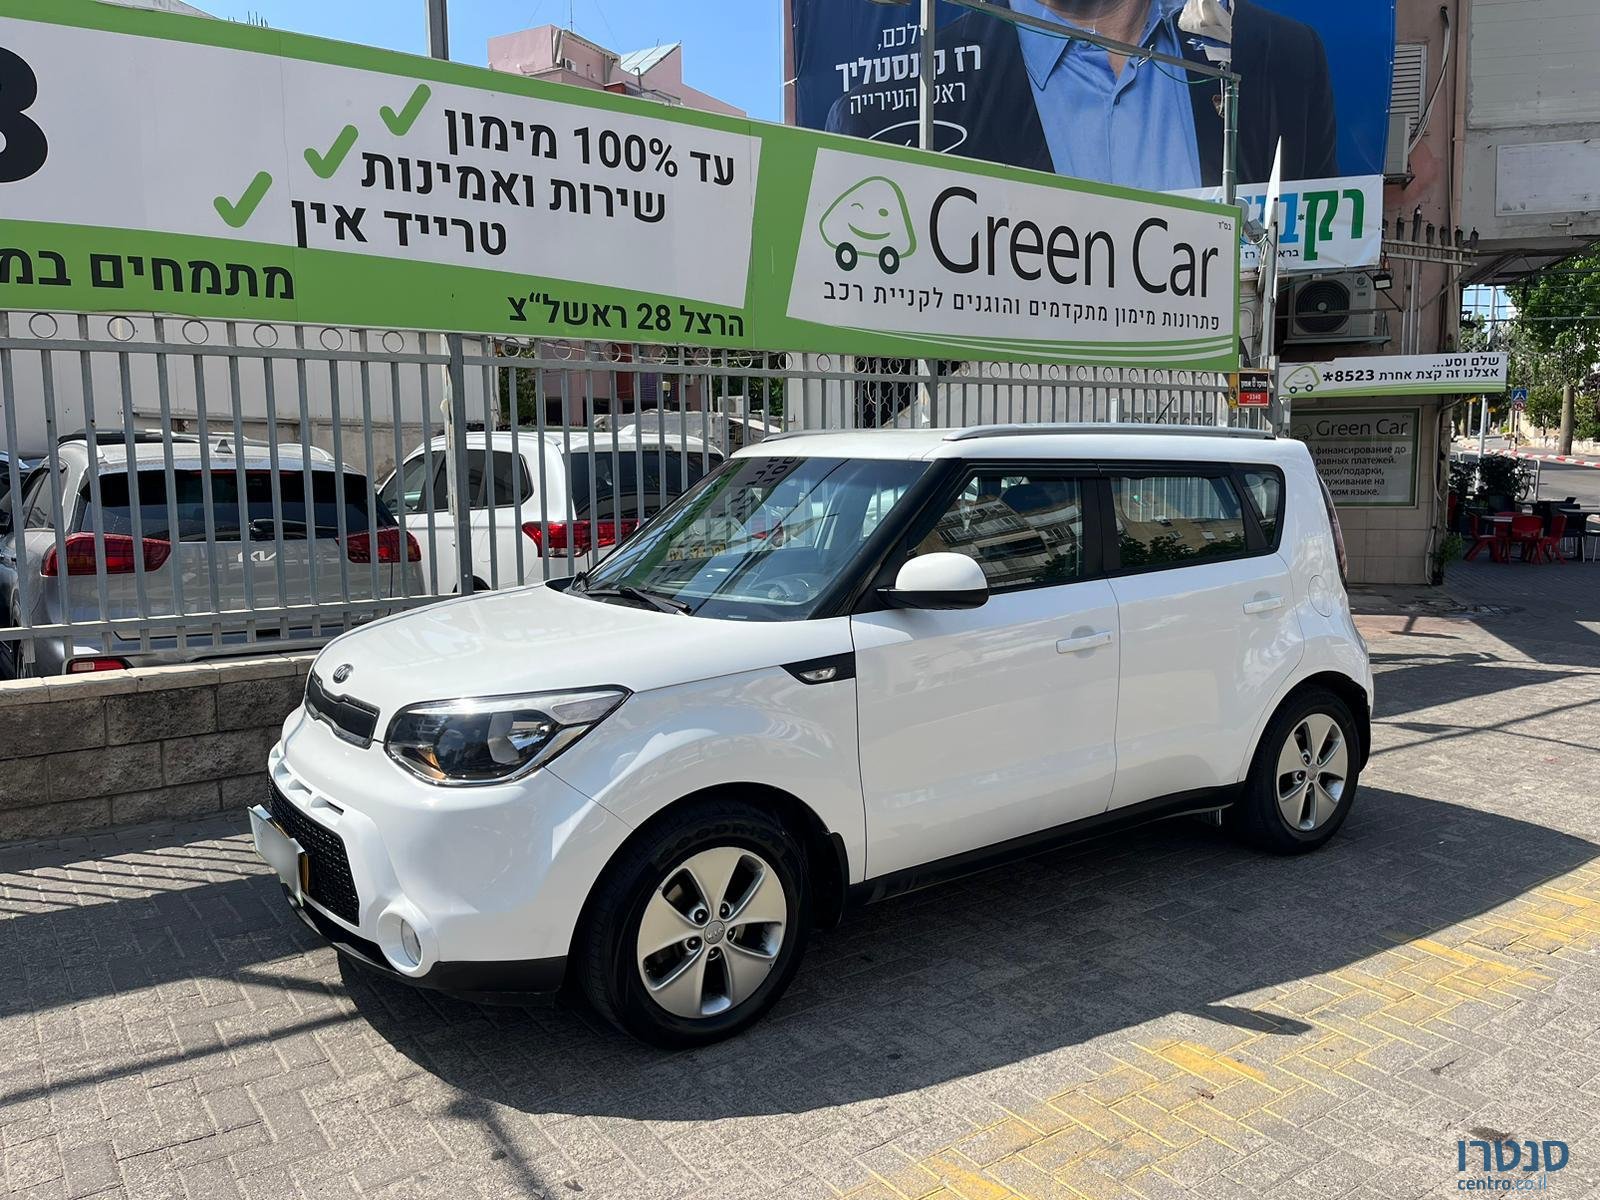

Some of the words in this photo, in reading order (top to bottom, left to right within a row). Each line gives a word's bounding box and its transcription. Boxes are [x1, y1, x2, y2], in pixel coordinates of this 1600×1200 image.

[877, 22, 927, 50] לכם,
[835, 49, 946, 92] קנסטליך
[954, 45, 981, 72] רז
[850, 88, 917, 115] העירייה
[444, 109, 557, 160] מימון
[573, 126, 678, 178] 100%
[361, 152, 535, 208] ואמינות
[689, 150, 734, 186] עד
[549, 178, 665, 223] שירות
[291, 199, 368, 249] אין
[383, 210, 507, 256] טרייד
[1302, 188, 1366, 262] רק
[929, 186, 1115, 289] Green
[1132, 217, 1219, 298] Car
[89, 253, 295, 300] מתמחים
[823, 281, 863, 302] רכב
[873, 286, 943, 313] לקניית
[953, 293, 1020, 315] והוגנים
[636, 302, 672, 332] 28
[679, 304, 744, 337] הרצל
[1029, 299, 1108, 325] מתקדמים
[1115, 307, 1156, 328] מימון
[1161, 311, 1219, 331] פתרונות
[1432, 357, 1467, 368] וסע...
[1446, 369, 1460, 379] זה
[1464, 367, 1499, 378] אצלנו
[1471, 355, 1500, 367] שלם
[1378, 370, 1412, 381] אחרת
[1415, 370, 1442, 381] קצת
[1316, 420, 1371, 436] Green
[1376, 418, 1408, 435] Car
[1315, 445, 1392, 456] финансирование
[1394, 447, 1407, 455] до
[1316, 458, 1349, 466] равных
[1351, 456, 1397, 465] платежей.
[1318, 467, 1384, 476] идки/подарки,
[1323, 478, 1372, 487] луживание
[1351, 488, 1380, 496] языке.
